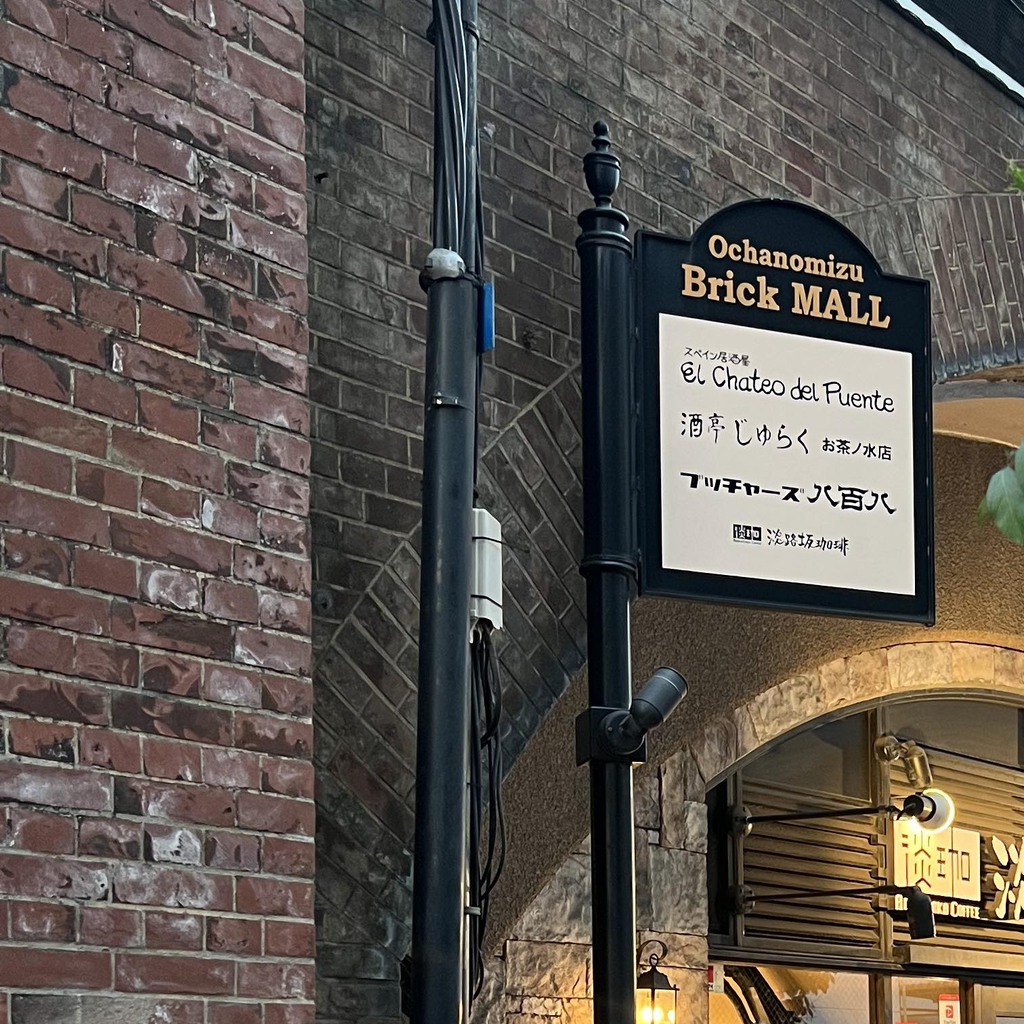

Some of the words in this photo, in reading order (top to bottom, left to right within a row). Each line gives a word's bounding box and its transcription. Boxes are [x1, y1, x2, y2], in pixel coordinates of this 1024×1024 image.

[708, 234, 864, 283] Ochanomizu
[681, 263, 780, 311] Brick
[791, 282, 891, 329] MALL
[684, 347, 750, 366] スペイン居酒屋
[712, 366, 785, 396] Chateo
[790, 377, 820, 402] del
[822, 381, 895, 413] Puente
[822, 437, 892, 461] お茶ノ水店
[767, 528, 849, 556] 淡路坂珈琲
